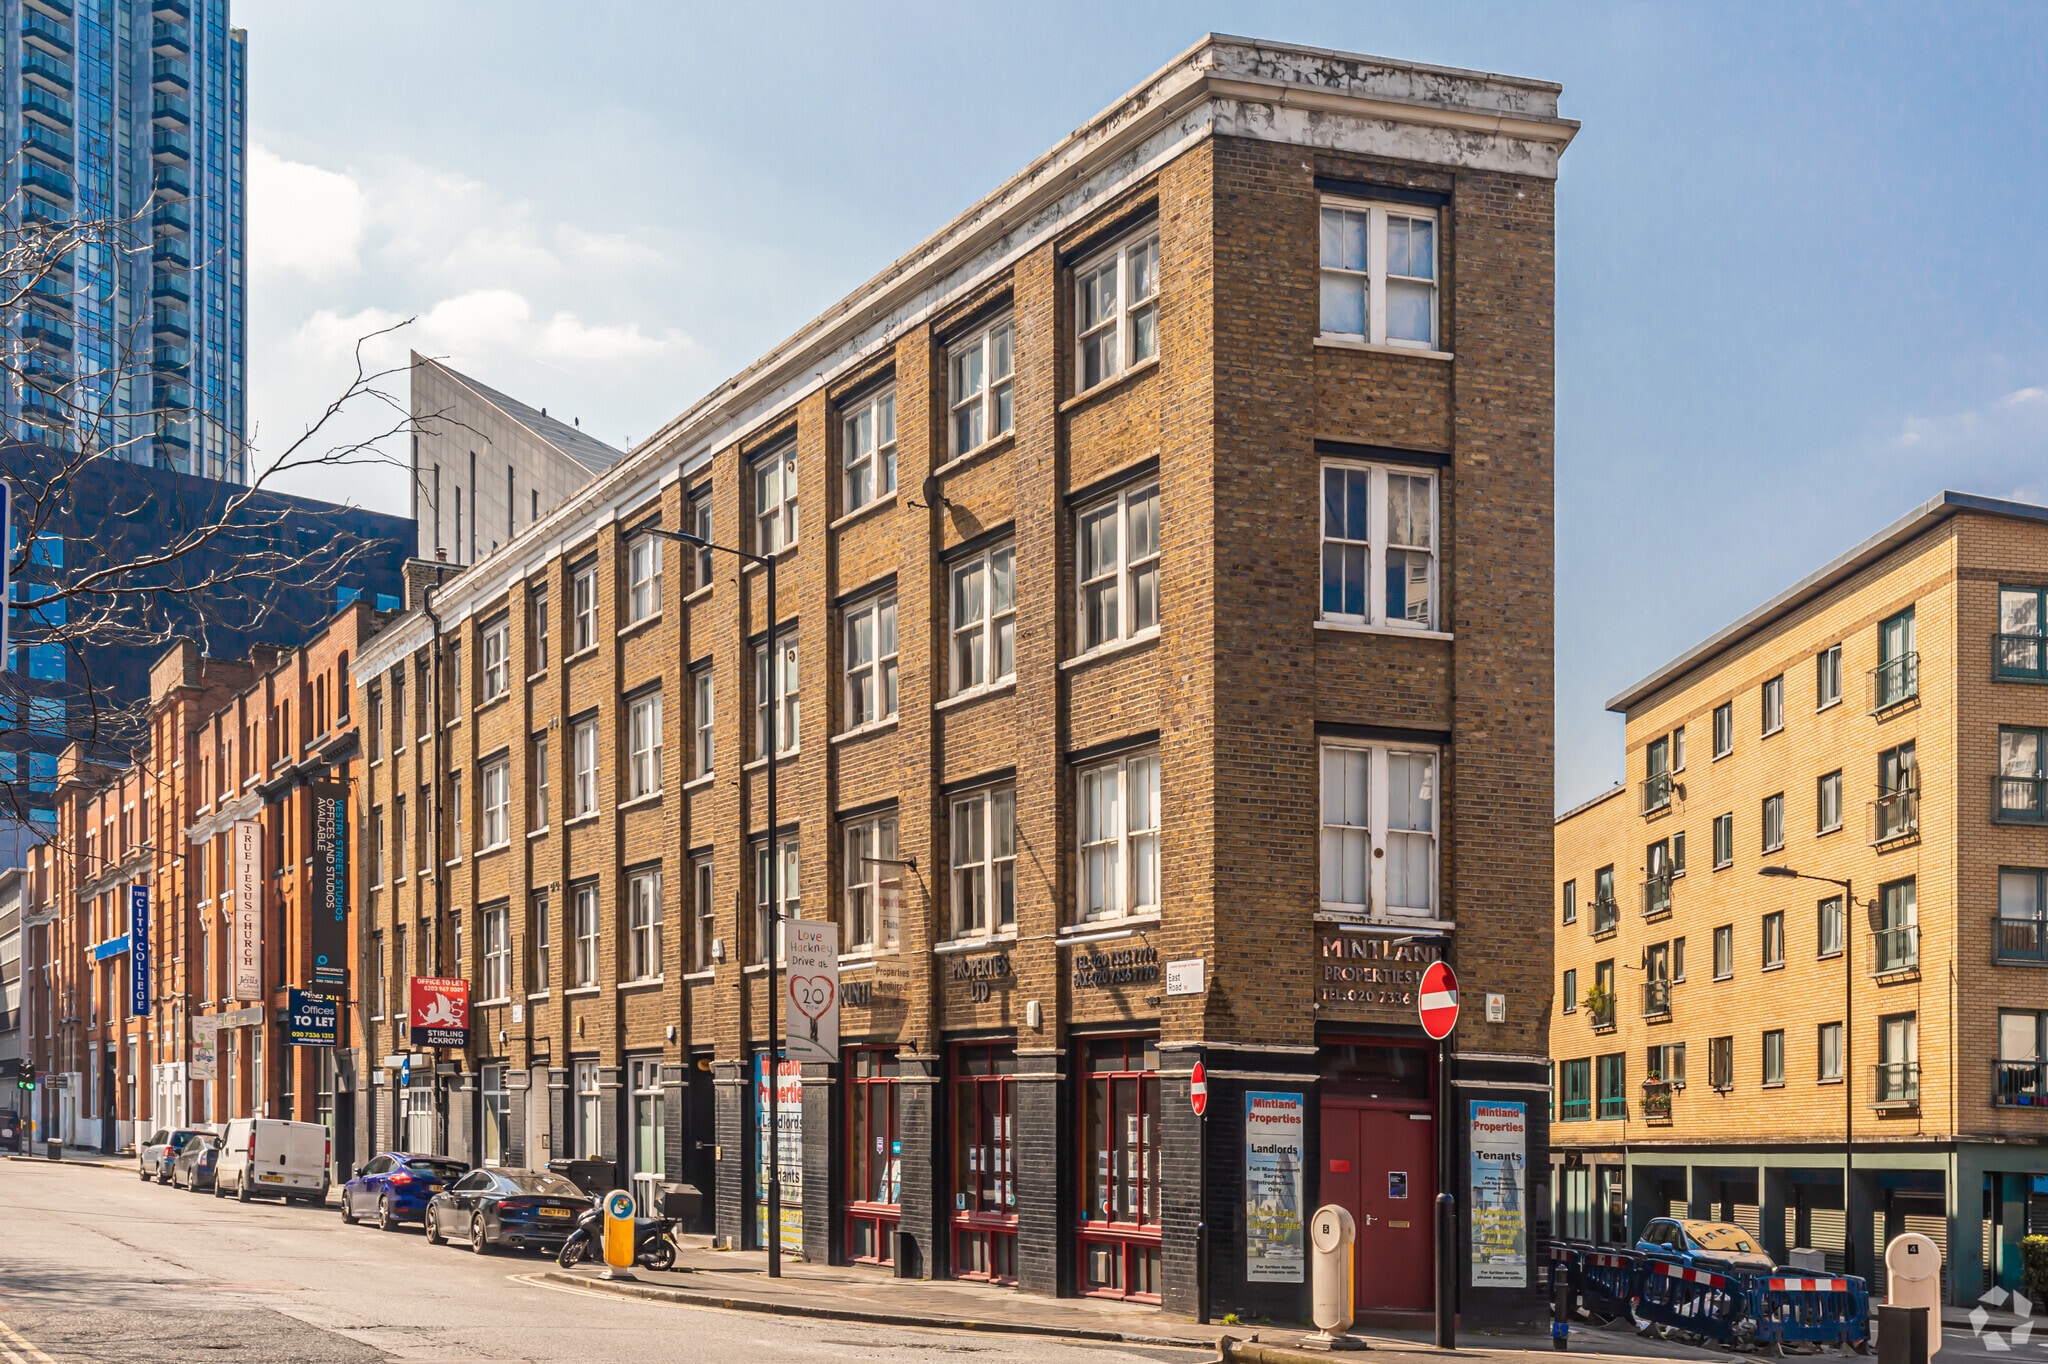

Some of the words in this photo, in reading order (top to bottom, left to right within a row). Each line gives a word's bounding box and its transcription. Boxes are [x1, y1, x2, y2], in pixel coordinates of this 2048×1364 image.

[317, 797, 326, 851] AVAILABLE
[326, 798, 335, 840] OFFICES
[336, 799, 344, 837] VESTRY
[244, 826, 252, 860] TRUE
[326, 842, 335, 864] AND
[336, 840, 344, 876] STREET
[244, 864, 252, 909] JESUS
[326, 866, 335, 908] STUDIOS
[336, 879, 344, 922] STUDIOS
[136, 899, 144, 936] CITY
[244, 913, 253, 965] CHURCH
[798, 929, 822, 942] Love
[790, 942, 833, 957] Hackney
[792, 956, 815, 966] Drive
[818, 960, 828, 968] at
[952, 953, 1008, 979] PROPERTIES
[136, 942, 145, 1009] COLLEGE
[876, 966, 910, 978] Properties
[1168, 973, 1181, 982] East
[1324, 965, 1413, 984] PROPERTIES
[970, 981, 990, 1003] LTD
[1168, 983, 1182, 991] Road
[802, 988, 824, 1005] 20
[1379, 991, 1411, 1004] 7336
[302, 1005, 334, 1015] Offices
[294, 1016, 312, 1026] TO
[316, 1017, 335, 1027] LET
[427, 1029, 464, 1037] STIRLING
[427, 1037, 464, 1045] ACKROYD
[1253, 1098, 1297, 1110] Mintland
[1248, 1112, 1302, 1125] Properties
[1477, 1107, 1519, 1118] Mintland
[1473, 1121, 1524, 1133] Properties
[1251, 1143, 1298, 1155] Landlords
[1476, 1151, 1522, 1160] Tenants
[1323, 1225, 1329, 1233] 5
